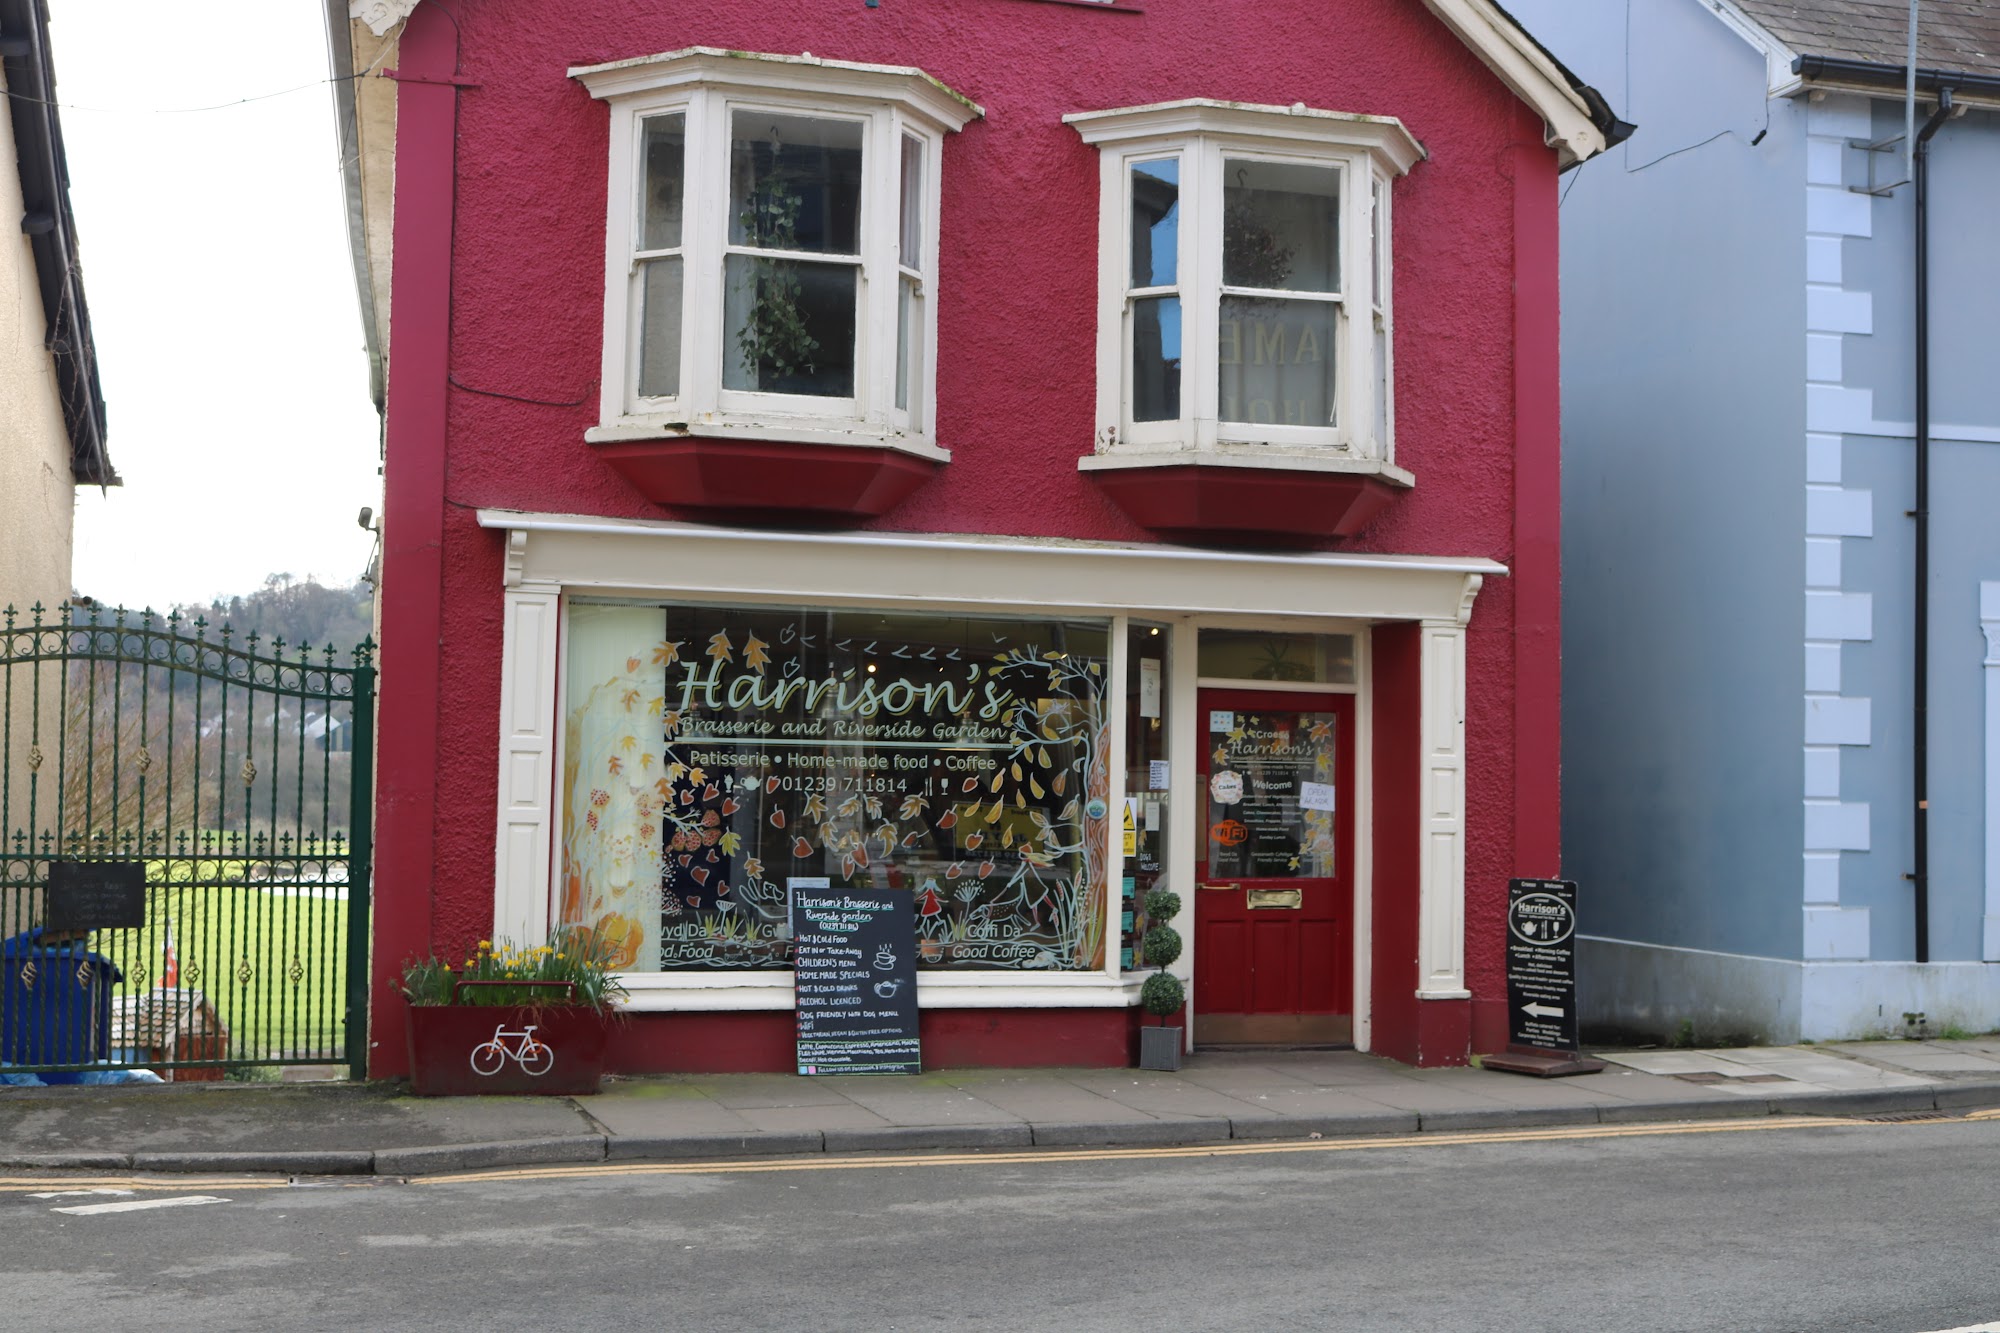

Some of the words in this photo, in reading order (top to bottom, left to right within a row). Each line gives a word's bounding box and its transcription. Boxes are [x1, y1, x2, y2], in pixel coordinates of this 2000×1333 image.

[677, 657, 1014, 721] Harrison's
[681, 716, 775, 736] Brasserie
[781, 718, 826, 736] and
[833, 718, 927, 738] Riverside
[932, 721, 1009, 740] Garden
[1256, 730, 1290, 740] Croeso
[1231, 740, 1314, 756] Harrison's
[690, 751, 770, 766] Patisserie
[787, 752, 888, 768] Home-made
[893, 753, 928, 768] food
[945, 755, 997, 770] Coffee
[782, 776, 836, 792] 01239
[843, 776, 908, 792] 711814
[1253, 778, 1293, 790] Welcome
[796, 891, 841, 908] Harrison's
[843, 896, 880, 909] Brasserie
[881, 901, 894, 909] and
[1518, 902, 1566, 915] Harrison's
[805, 909, 840, 920] Riverside
[841, 910, 873, 922] garden
[688, 924, 706, 937] Da
[1003, 924, 1021, 937] Da
[678, 944, 714, 958] Food
[952, 945, 988, 958] Good
[993, 945, 1036, 958] Coffee
[798, 971, 819, 979] HOME
[819, 971, 838, 979] MADE
[840, 970, 870, 979] SPECIALS
[799, 997, 828, 1006] ALCOHOL
[816, 1010, 846, 1019] FRIENDLY
